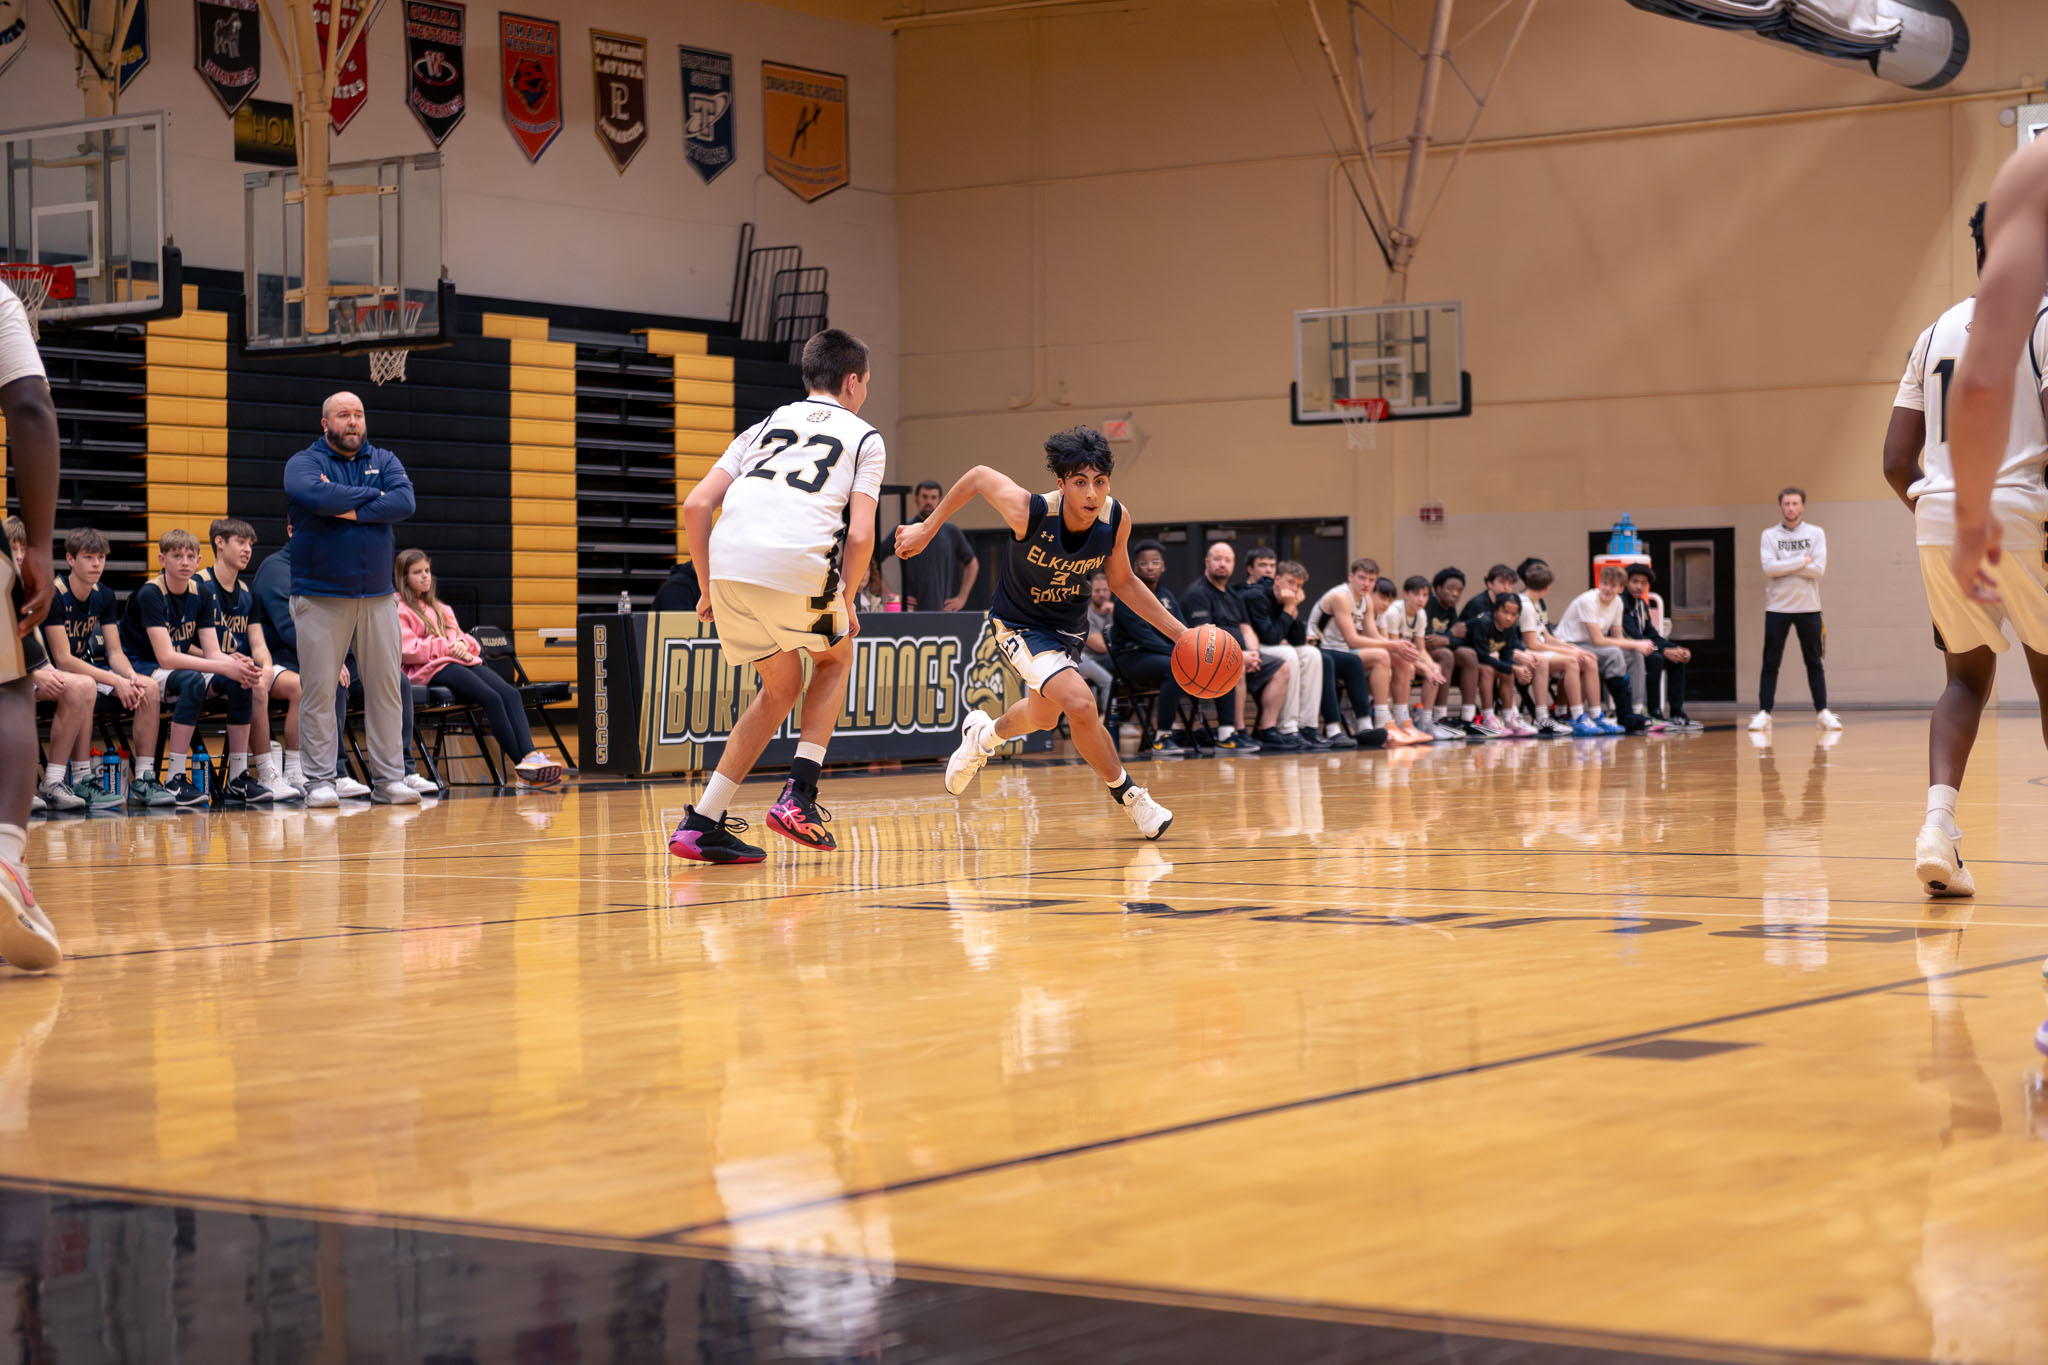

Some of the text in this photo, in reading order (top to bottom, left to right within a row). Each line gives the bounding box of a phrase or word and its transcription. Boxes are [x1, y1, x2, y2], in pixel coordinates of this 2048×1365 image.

[313, 9, 356, 29] SOT
[409, 4, 459, 28] OMAHA
[505, 22, 554, 43] OMAHA
[253, 114, 297, 147] HOM
[744, 426, 844, 494] 23
[1026, 544, 1106, 575] ELKHORN
[1050, 571, 1071, 586] 3
[1030, 584, 1081, 604] SOUTH
[595, 625, 607, 763] BULLDOGS
[793, 646, 957, 730] BLDOGS
